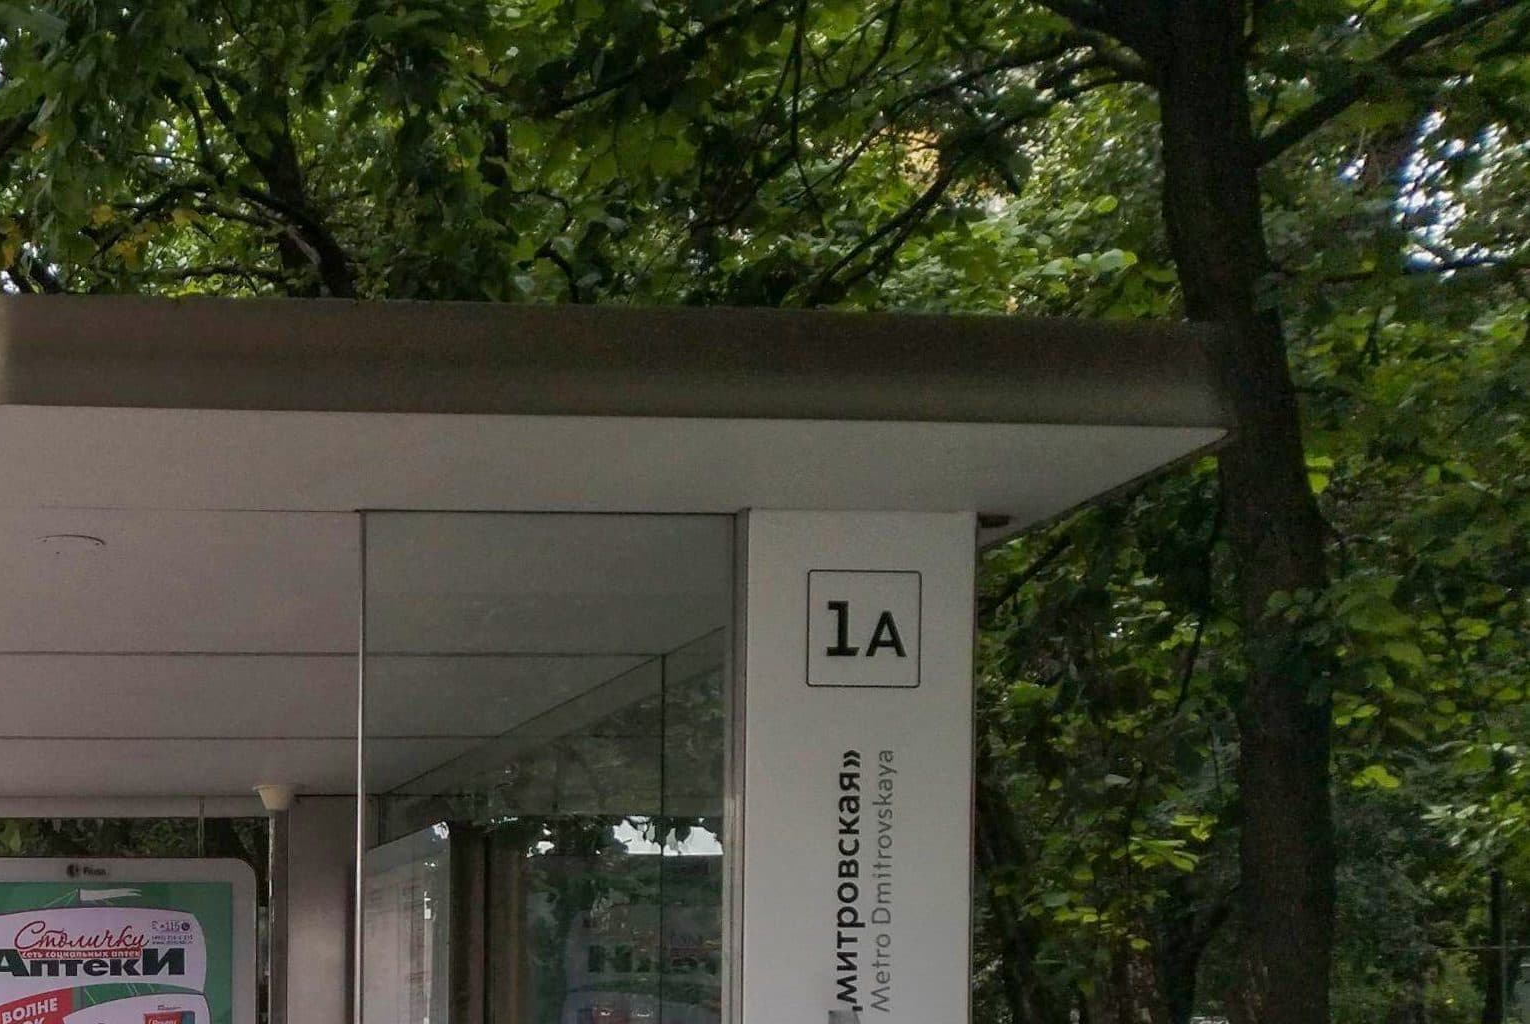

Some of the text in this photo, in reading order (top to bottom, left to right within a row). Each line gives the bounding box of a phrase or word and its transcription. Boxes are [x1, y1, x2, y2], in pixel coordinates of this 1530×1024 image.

[871, 750, 897, 1013] Metro Dmitrovskaya
[15, 920, 150, 949] Столички
[1, 998, 58, 1024] ВОЛНЕ
